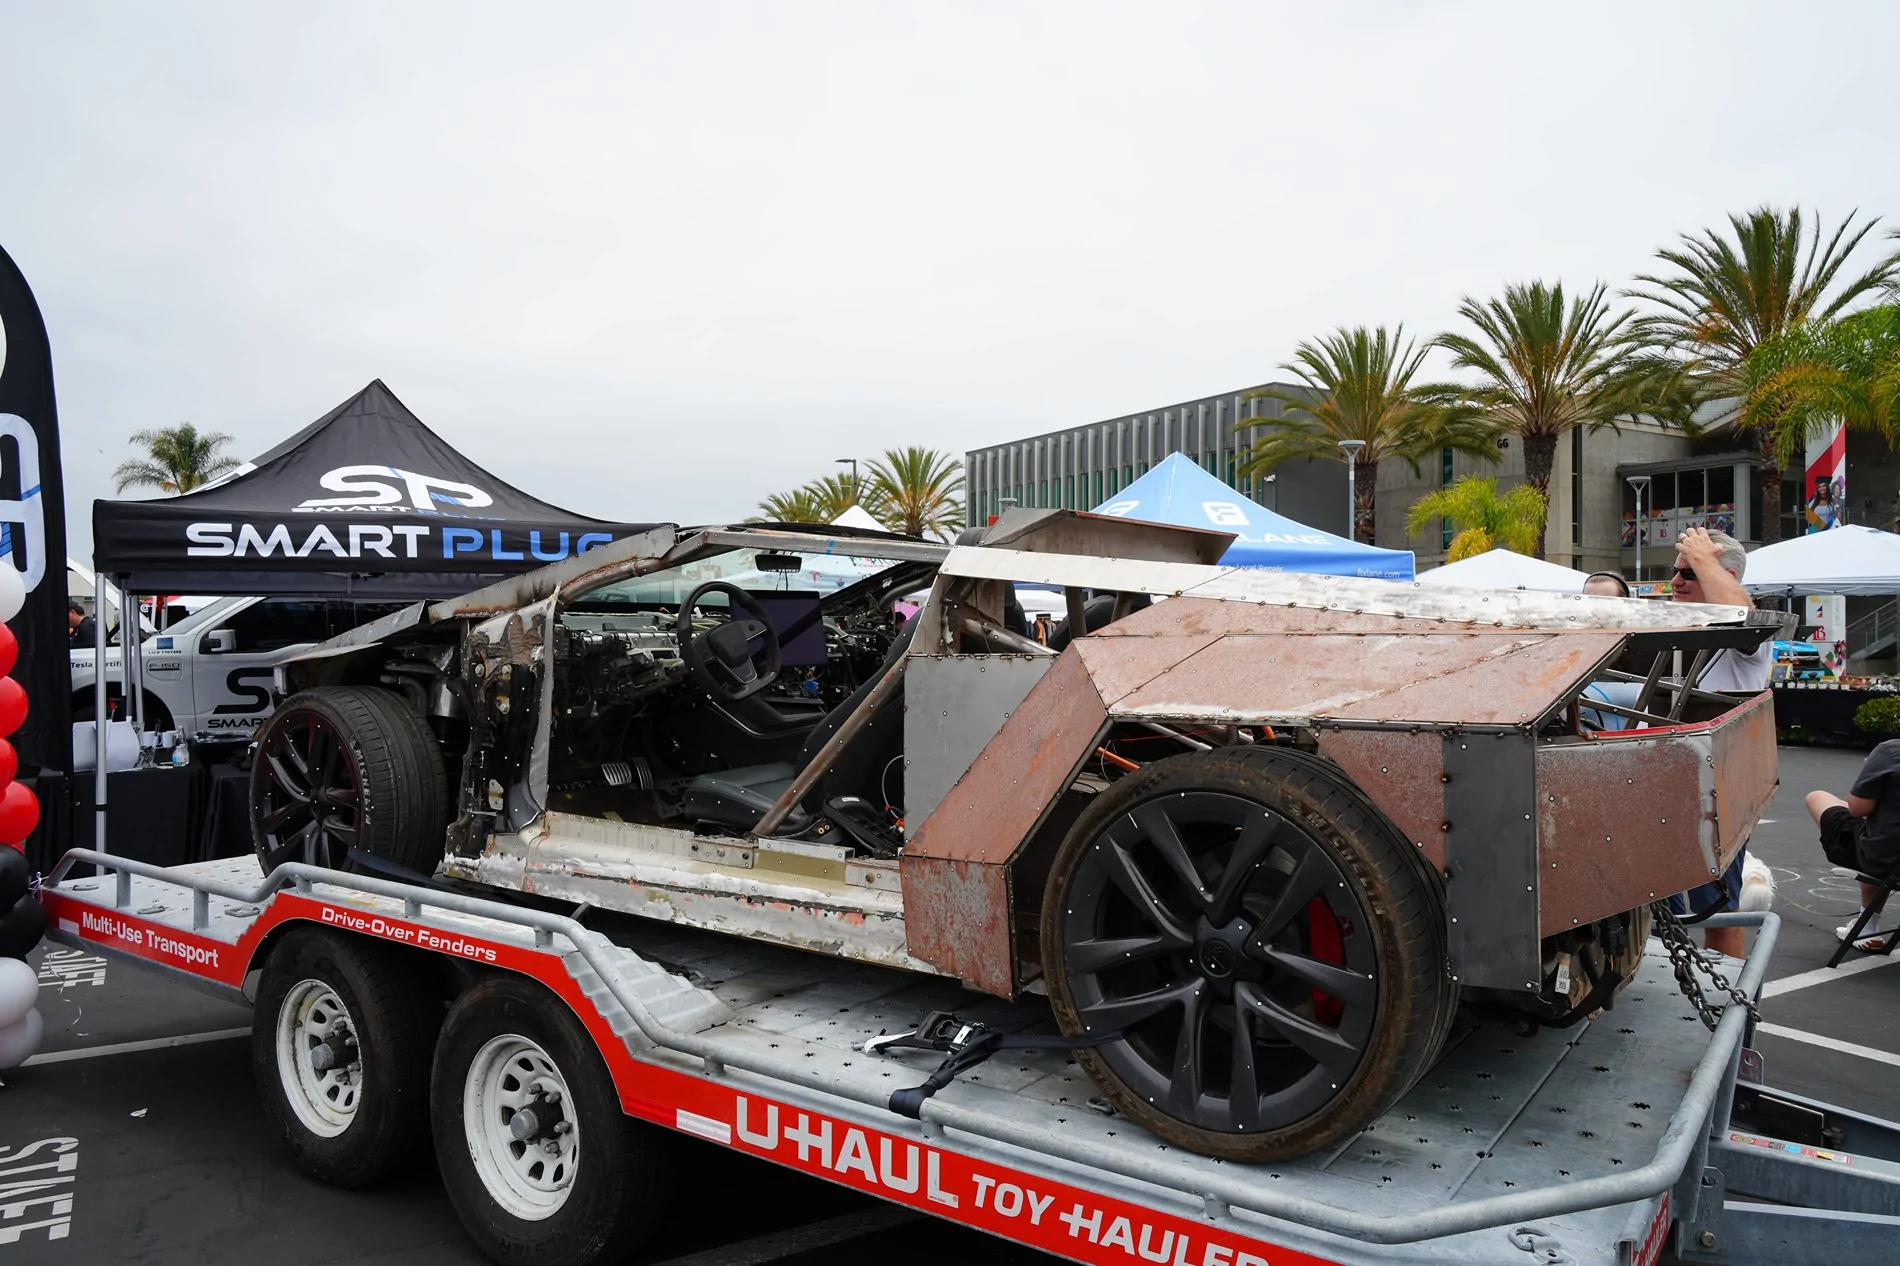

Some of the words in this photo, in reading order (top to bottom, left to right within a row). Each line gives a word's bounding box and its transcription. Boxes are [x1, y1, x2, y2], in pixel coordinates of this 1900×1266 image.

[187, 523, 430, 558] SMART
[70, 661, 93, 669] Tesla
[208, 717, 268, 728] SMAR
[1305, 811, 1388, 915] MICHELIN
[82, 911, 143, 944] Multi-Use
[145, 929, 219, 967] Transport
[321, 907, 415, 940] Drive-Over
[417, 929, 497, 961] Fenders
[736, 1095, 959, 1208] U-HAUL
